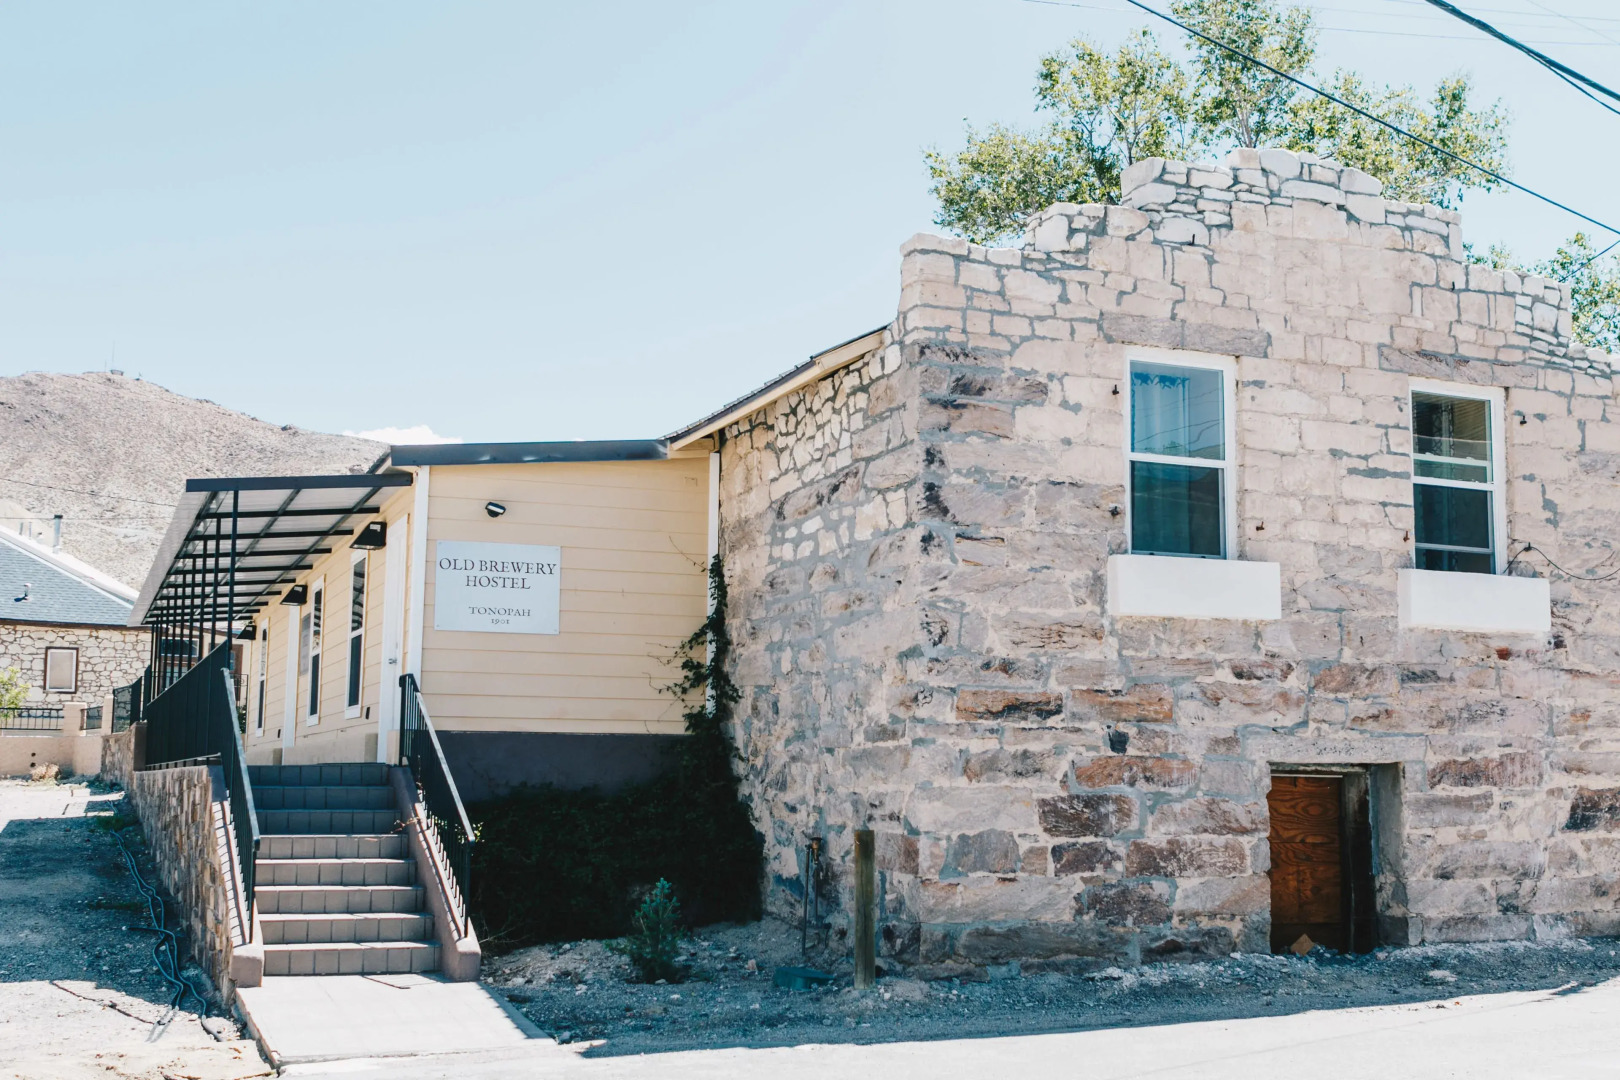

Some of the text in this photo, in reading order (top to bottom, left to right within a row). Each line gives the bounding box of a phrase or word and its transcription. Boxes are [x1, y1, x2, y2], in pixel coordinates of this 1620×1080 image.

[439, 557, 557, 575] OLD BREWERY
[465, 575, 531, 589] HOSTEL
[468, 606, 531, 617] TONOPAH
